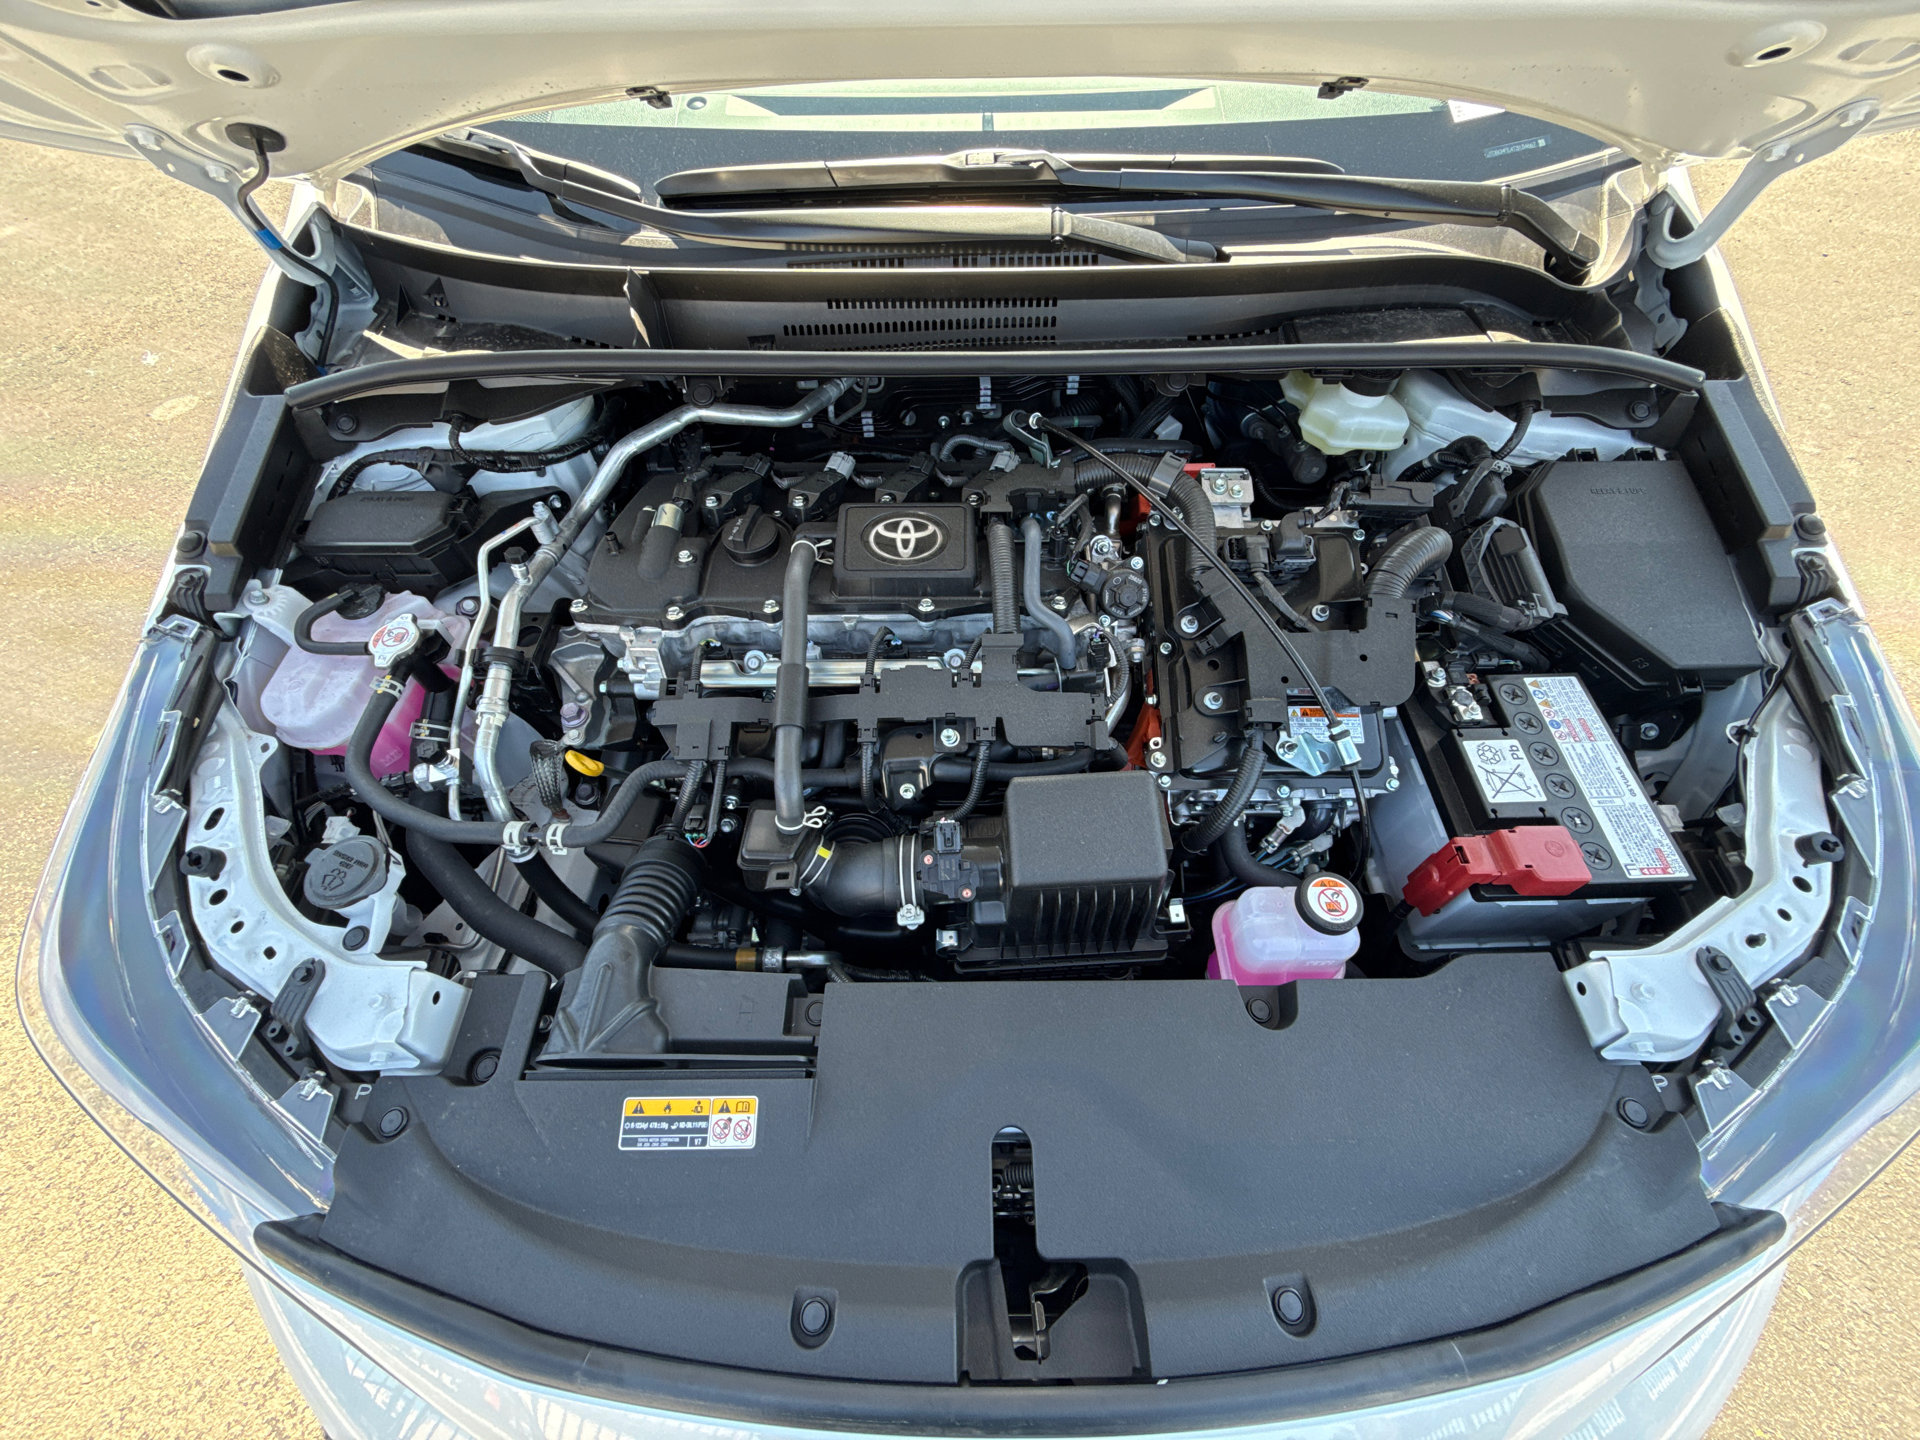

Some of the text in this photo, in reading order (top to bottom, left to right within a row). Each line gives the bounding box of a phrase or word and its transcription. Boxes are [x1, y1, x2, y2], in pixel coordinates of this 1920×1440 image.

[1509, 744, 1525, 760] Pb
[1615, 766, 1638, 798] GS YUASA
